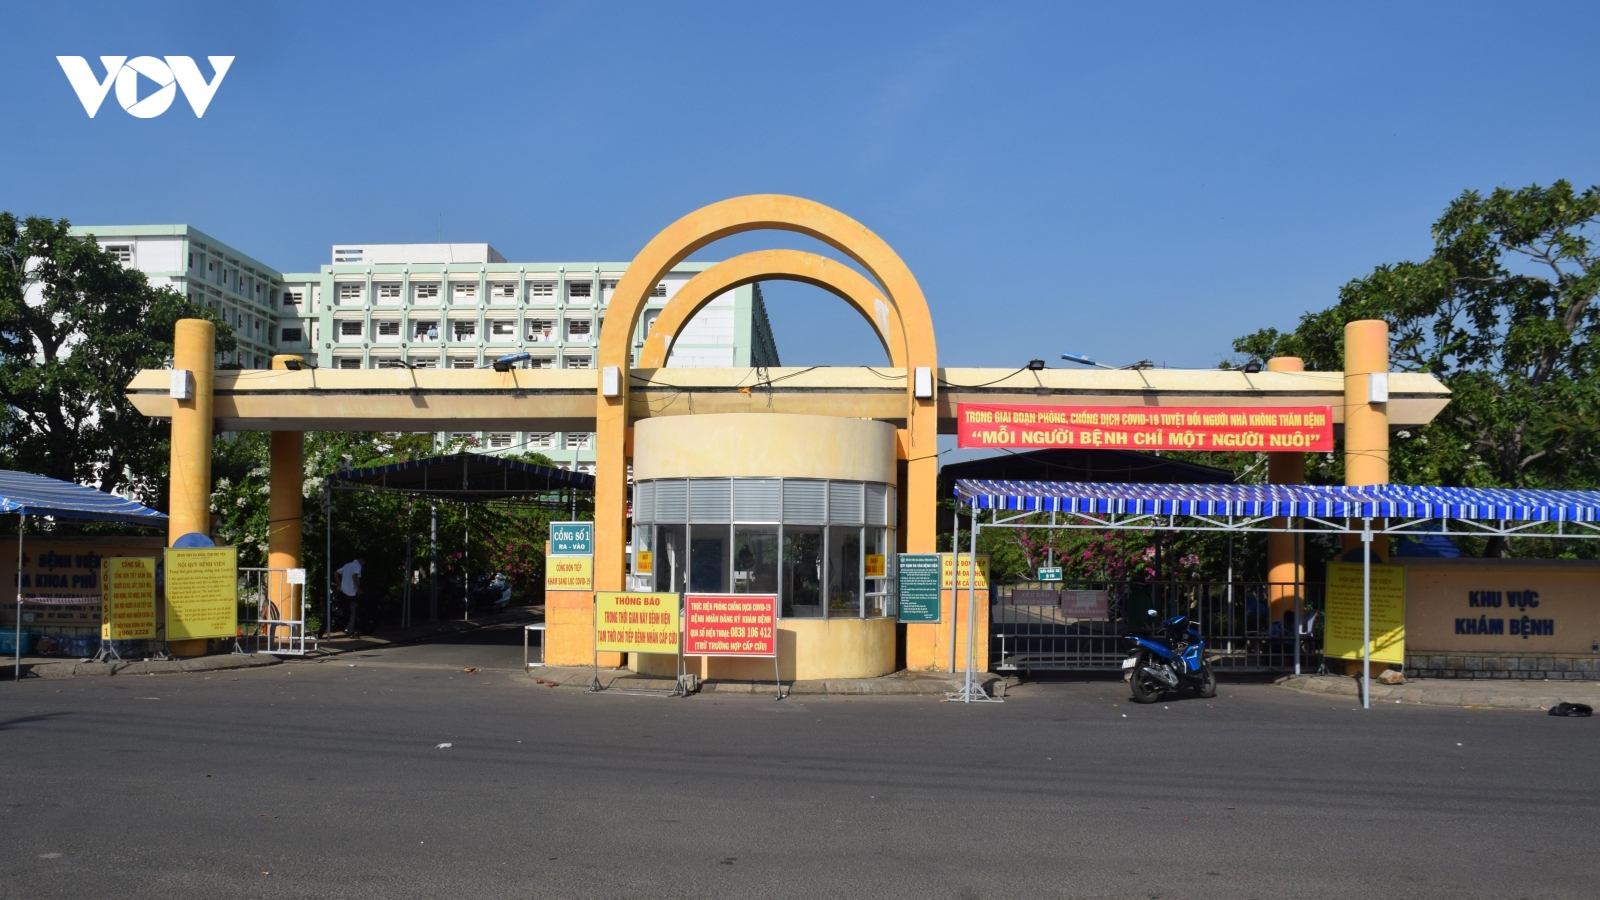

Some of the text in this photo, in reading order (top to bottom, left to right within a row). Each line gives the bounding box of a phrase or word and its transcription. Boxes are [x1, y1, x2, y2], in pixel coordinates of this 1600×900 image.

[965, 411, 992, 424] TRONG
[994, 411, 1010, 424] GIAI
[1013, 412, 1036, 426] ĐOẠN
[1070, 410, 1099, 425] CHỐNG
[1100, 413, 1120, 427] DỊCH
[1122, 413, 1159, 426] COVID-19
[1161, 412, 1185, 428] TUYỆT
[1187, 410, 1201, 426] ĐỐI
[1203, 411, 1229, 426] NGƯỜI
[1230, 412, 1247, 427] NHÀ
[1249, 412, 1277, 427] KHÔNG
[1279, 412, 1302, 427] THĂM
[1304, 412, 1325, 429] BỆNH
[1021, 427, 1074, 445] NGƯỜI
[1080, 428, 1128, 447] BỆNH
[1133, 429, 1163, 446] CHỈ
[1168, 430, 1206, 448] MỘT
[1212, 430, 1264, 447] NGƯỜI
[554, 527, 590, 541] CỔNG SỐ 1
[39, 550, 72, 572] BỆNH
[121, 559, 134, 568] CỔNG
[134, 559, 141, 568] SỐ
[945, 558, 960, 566] CỔG
[976, 558, 986, 567] IẾP
[35, 574, 68, 588] KHOA
[962, 578, 970, 586] CẤ
[615, 596, 660, 606] THÔNG BÁO
[691, 602, 702, 612] THỰC
[728, 600, 741, 612] CHỐNG
[742, 603, 752, 613] DỊCH
[753, 603, 771, 612] COVID-19
[1468, 590, 1540, 612] KHU VỰC
[604, 611, 618, 624] TRONG
[618, 609, 628, 624] THỜI
[629, 612, 638, 624] GIAN
[648, 610, 660, 627] BỆNH
[660, 610, 670, 626] VIỆN
[691, 613, 772, 625] BỆNH NHÂN ĐĂNG KÝ KHÁM BỆNH
[690, 629, 698, 638] QUA
[699, 626, 706, 637] SỐ
[706, 627, 716, 638] ĐIỆN
[730, 627, 745, 638] 0838
[747, 627, 758, 638] 106
[760, 627, 772, 638] 412
[1455, 614, 1554, 639] KHÁM BỆNH
[597, 630, 606, 645] TẠM
[607, 628, 616, 643] THỜI
[625, 628, 634, 643] TIẾP
[635, 629, 646, 646] BỆNH
[647, 629, 658, 644] NHÂN
[659, 627, 668, 644] CẤP
[669, 630, 677, 644] CỨU
[708, 640, 729, 650] TRƯỜNG
[730, 641, 741, 651] HỢP
[742, 640, 753, 651] CẤP
